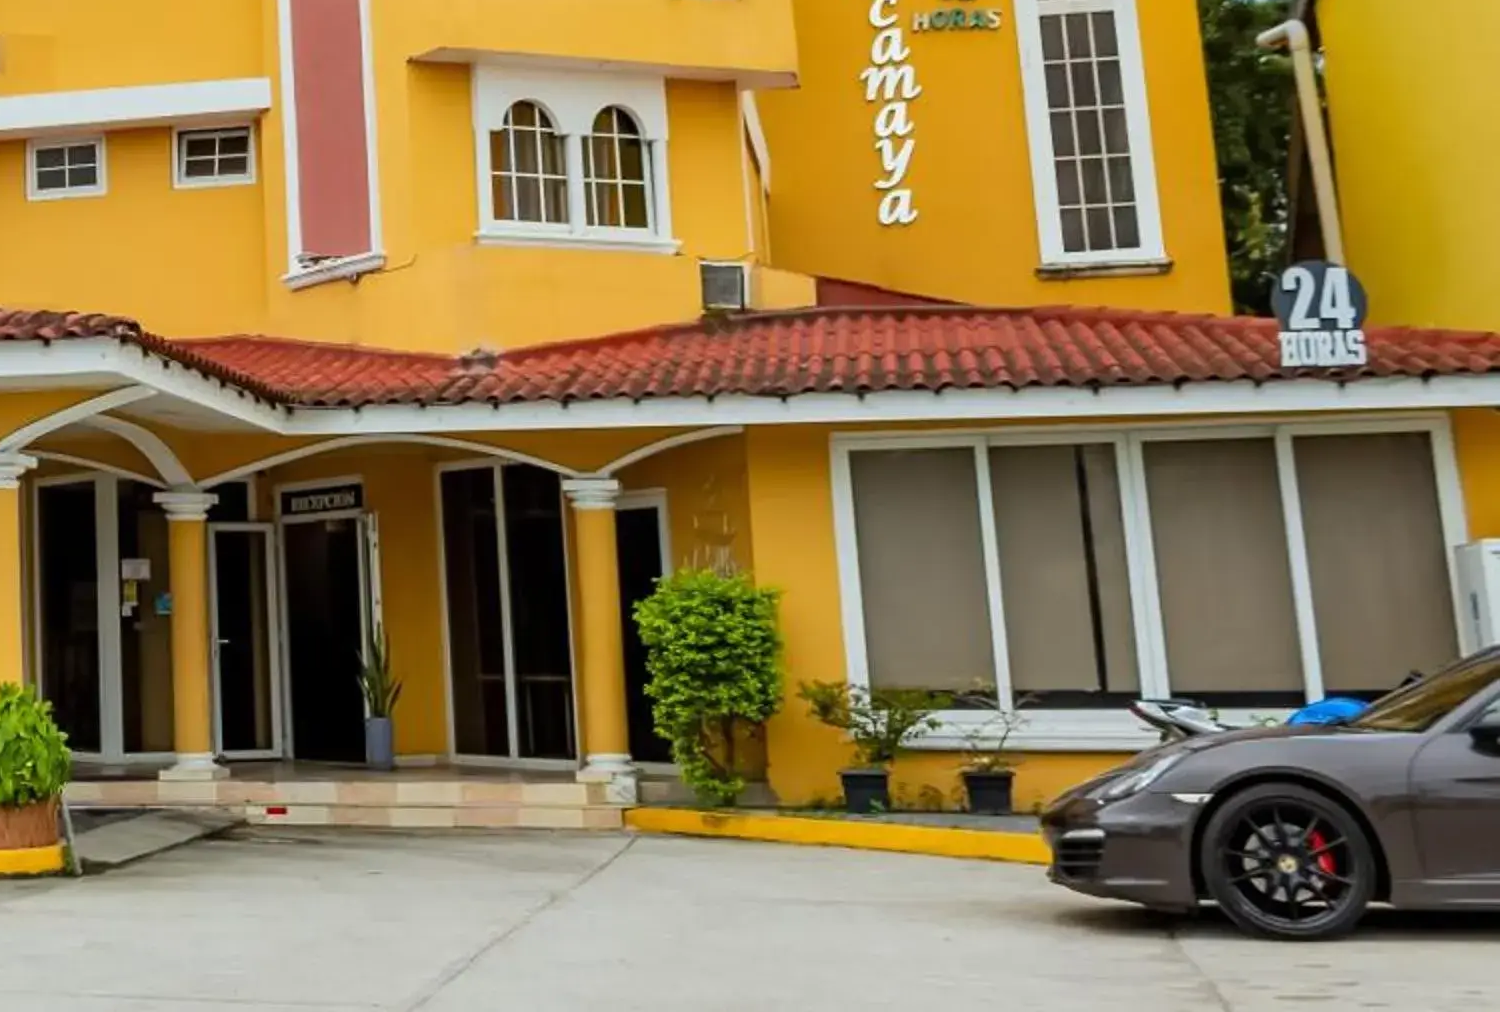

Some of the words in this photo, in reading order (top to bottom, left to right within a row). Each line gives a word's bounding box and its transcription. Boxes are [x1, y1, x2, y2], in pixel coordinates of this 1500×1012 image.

[912, 8, 1003, 33] HORAS
[1281, 266, 1357, 330] 24
[1277, 330, 1368, 367] HORAS
